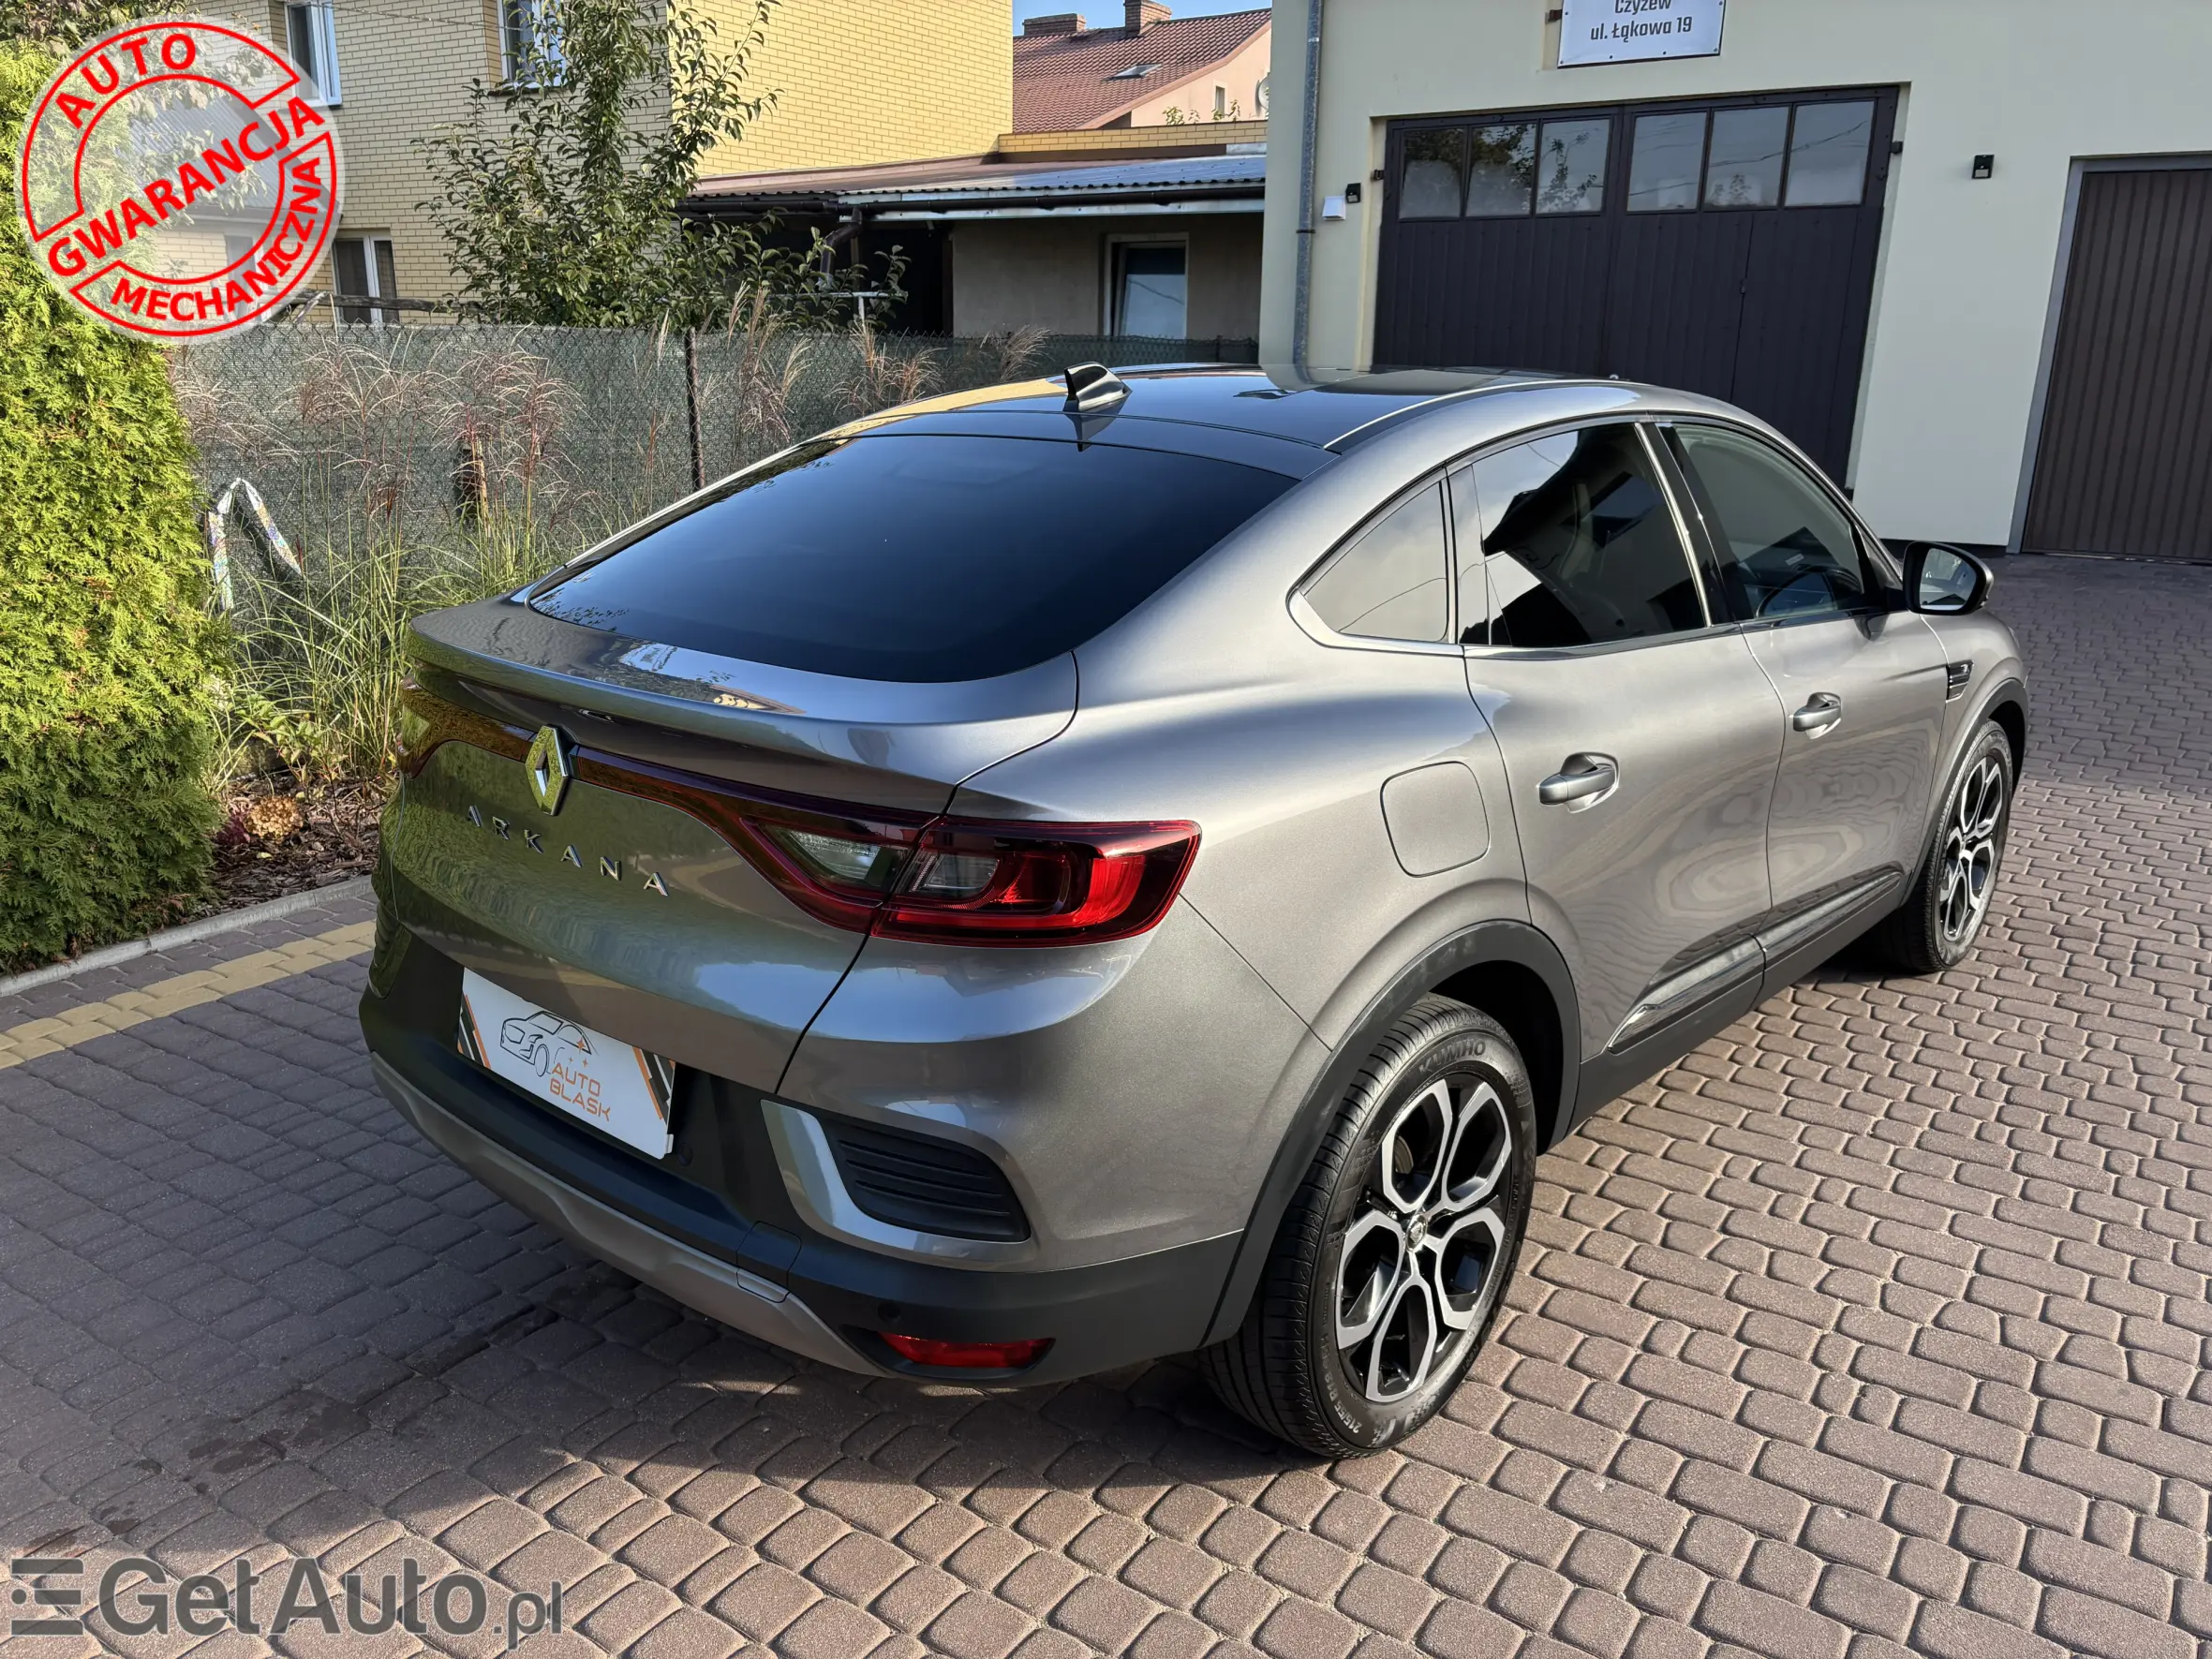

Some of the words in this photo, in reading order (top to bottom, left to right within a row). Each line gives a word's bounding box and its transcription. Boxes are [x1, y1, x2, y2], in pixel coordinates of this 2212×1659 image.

[1590, 22, 1608, 40] ul.
[1611, 20, 1672, 43] Łąkowa
[1676, 16, 1693, 33] 19
[468, 805, 669, 896] ARKANA
[1418, 1038, 1487, 1074] KUMHO
[552, 1061, 601, 1097] AUTO
[549, 1077, 611, 1122] BLASK
